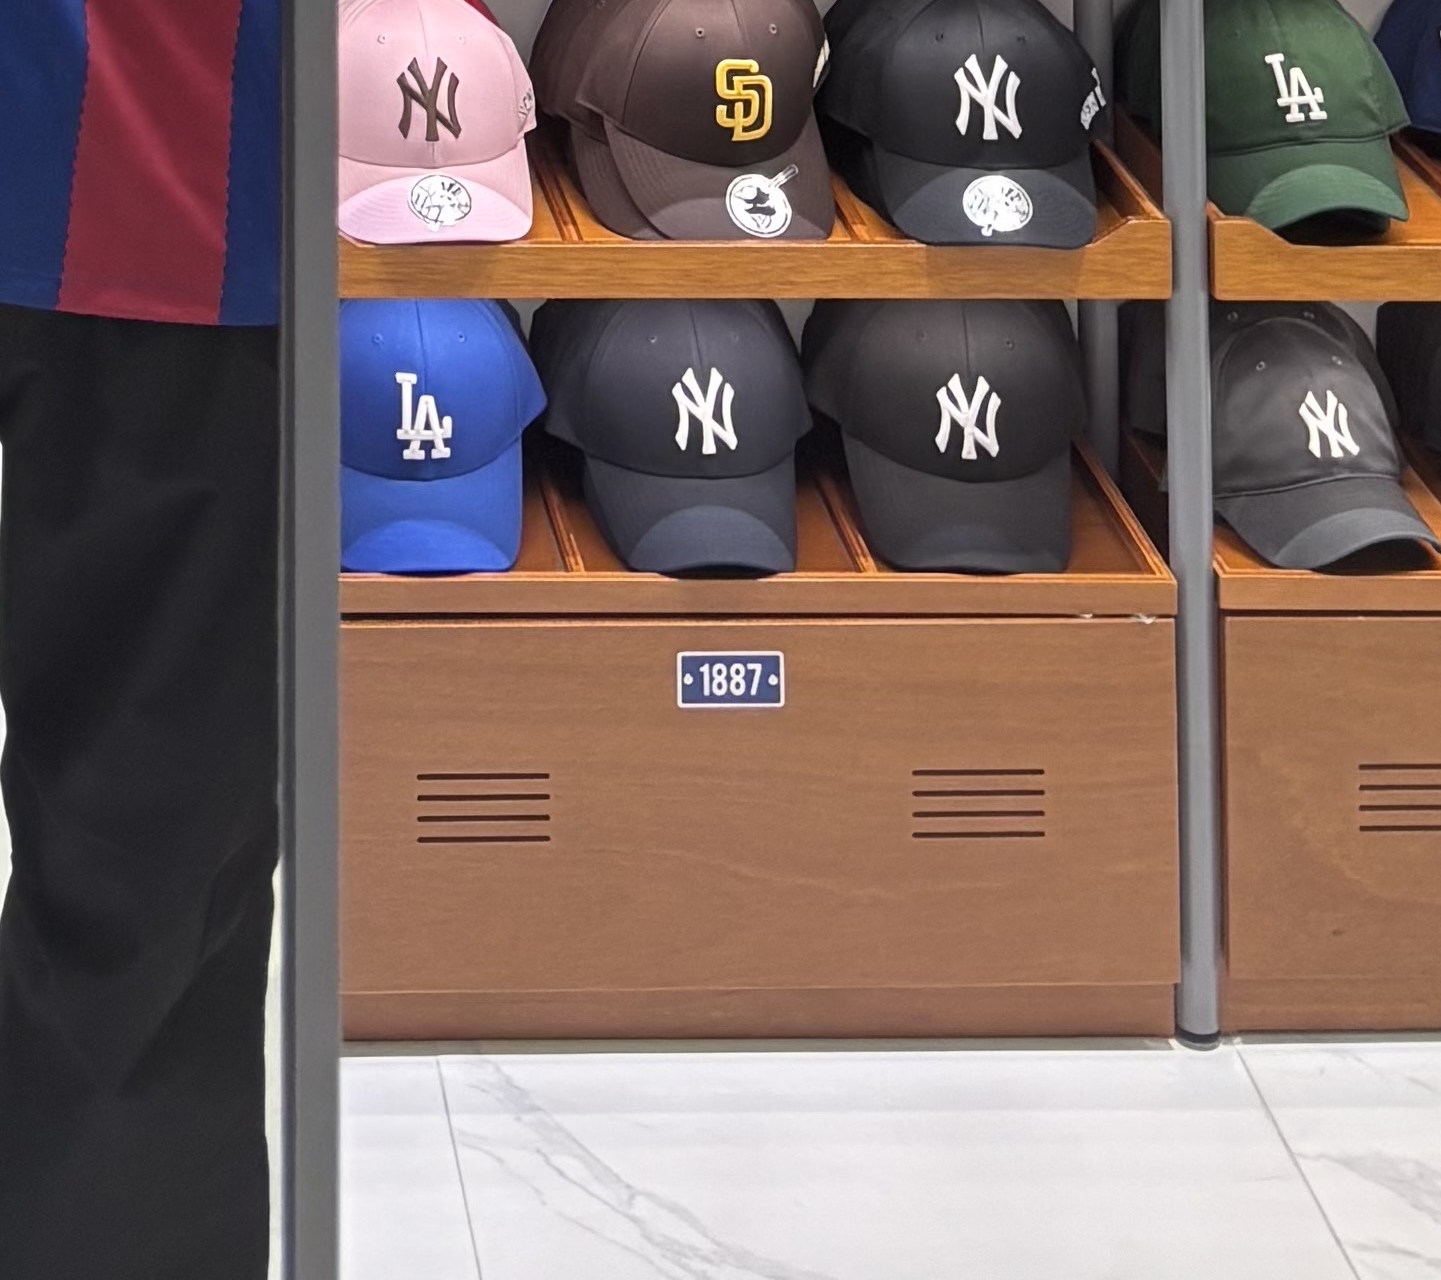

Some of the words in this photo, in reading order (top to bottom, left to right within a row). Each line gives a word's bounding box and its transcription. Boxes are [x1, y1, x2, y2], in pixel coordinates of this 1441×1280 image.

[396, 56, 463, 142] NY
[715, 58, 773, 142] SD
[954, 53, 1023, 141] NY
[1264, 52, 1327, 123] LA
[395, 371, 452, 460] LA
[671, 366, 738, 455] NY
[935, 372, 1002, 460] NY
[1298, 389, 1360, 459] NY
[698, 663, 763, 698] 1887
